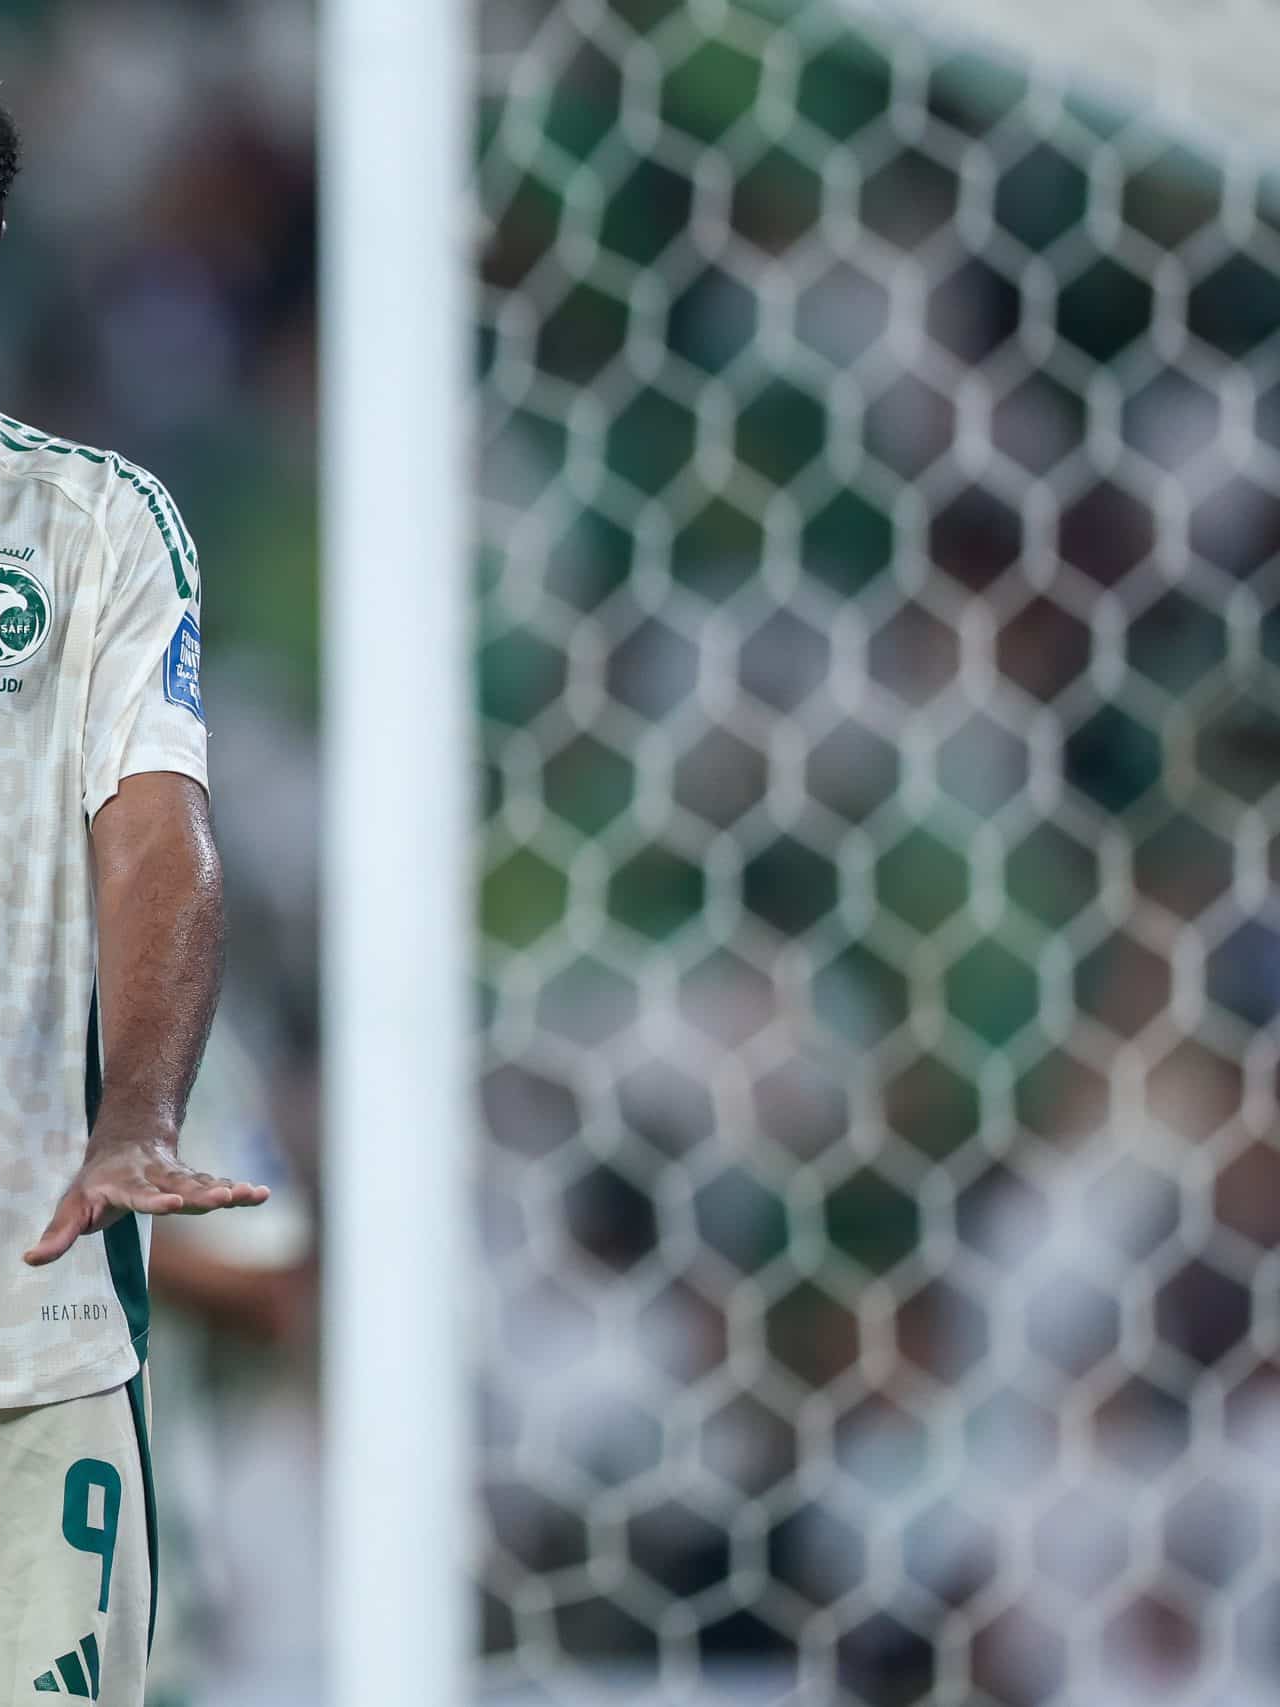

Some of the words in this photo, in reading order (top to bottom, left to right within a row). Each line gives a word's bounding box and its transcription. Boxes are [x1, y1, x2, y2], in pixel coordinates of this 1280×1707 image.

[0, 624, 31, 634] SAFF
[41, 1303, 109, 1321] HEAT.RDY
[62, 1457, 122, 1614] 9
